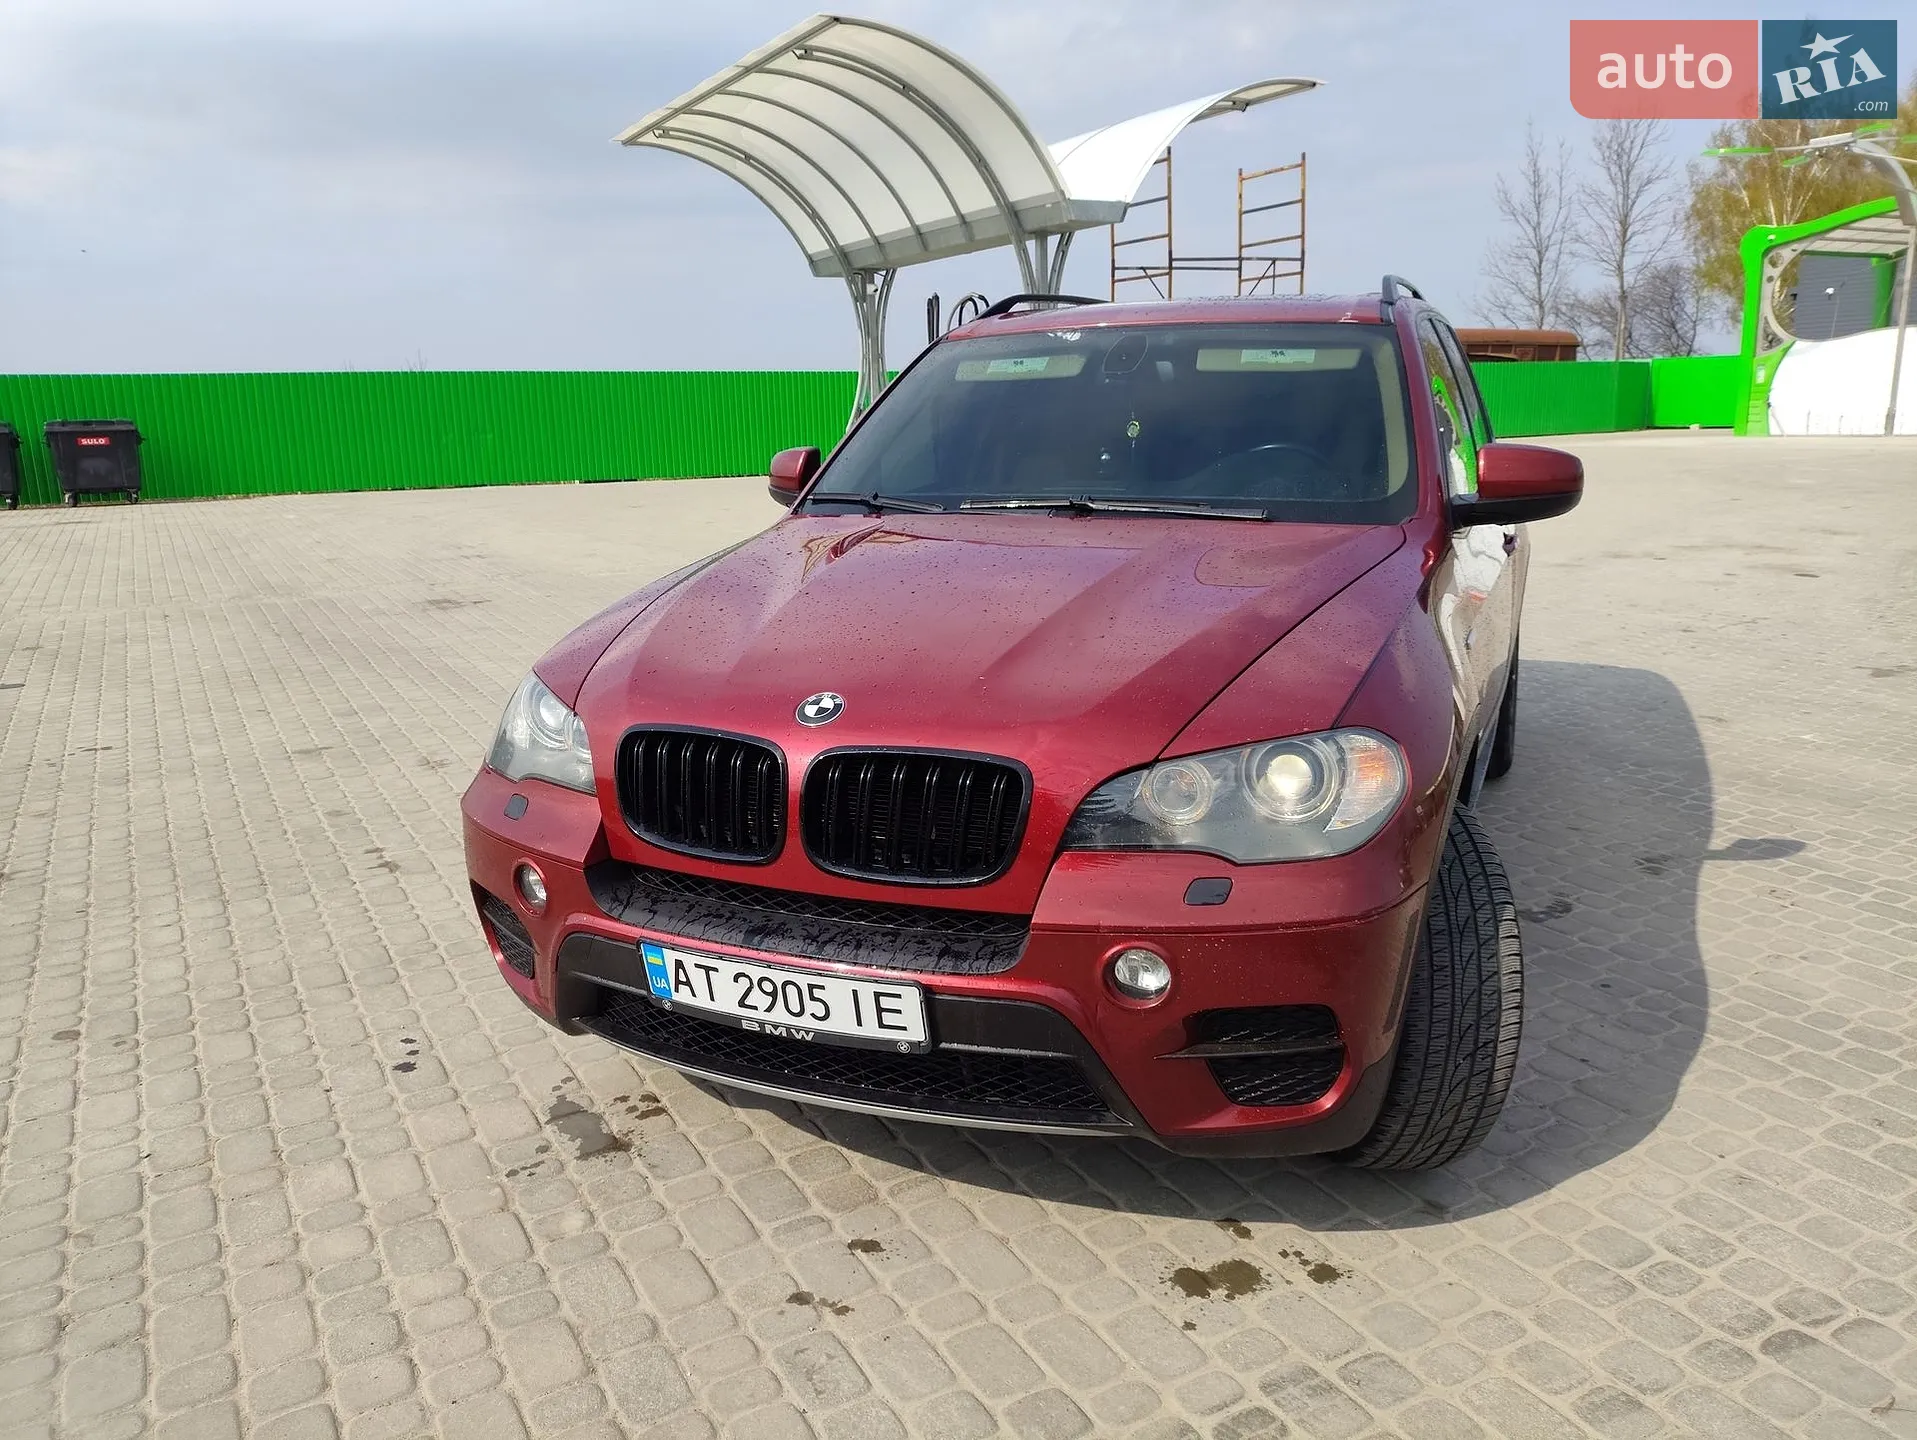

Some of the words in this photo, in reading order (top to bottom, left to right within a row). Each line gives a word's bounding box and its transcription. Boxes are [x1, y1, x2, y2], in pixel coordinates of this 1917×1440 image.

[652, 975, 670, 991] UA
[674, 958, 719, 1002] AT
[733, 972, 831, 1022] 2905
[852, 988, 909, 1032] IE
[741, 1019, 816, 1042] BMW
